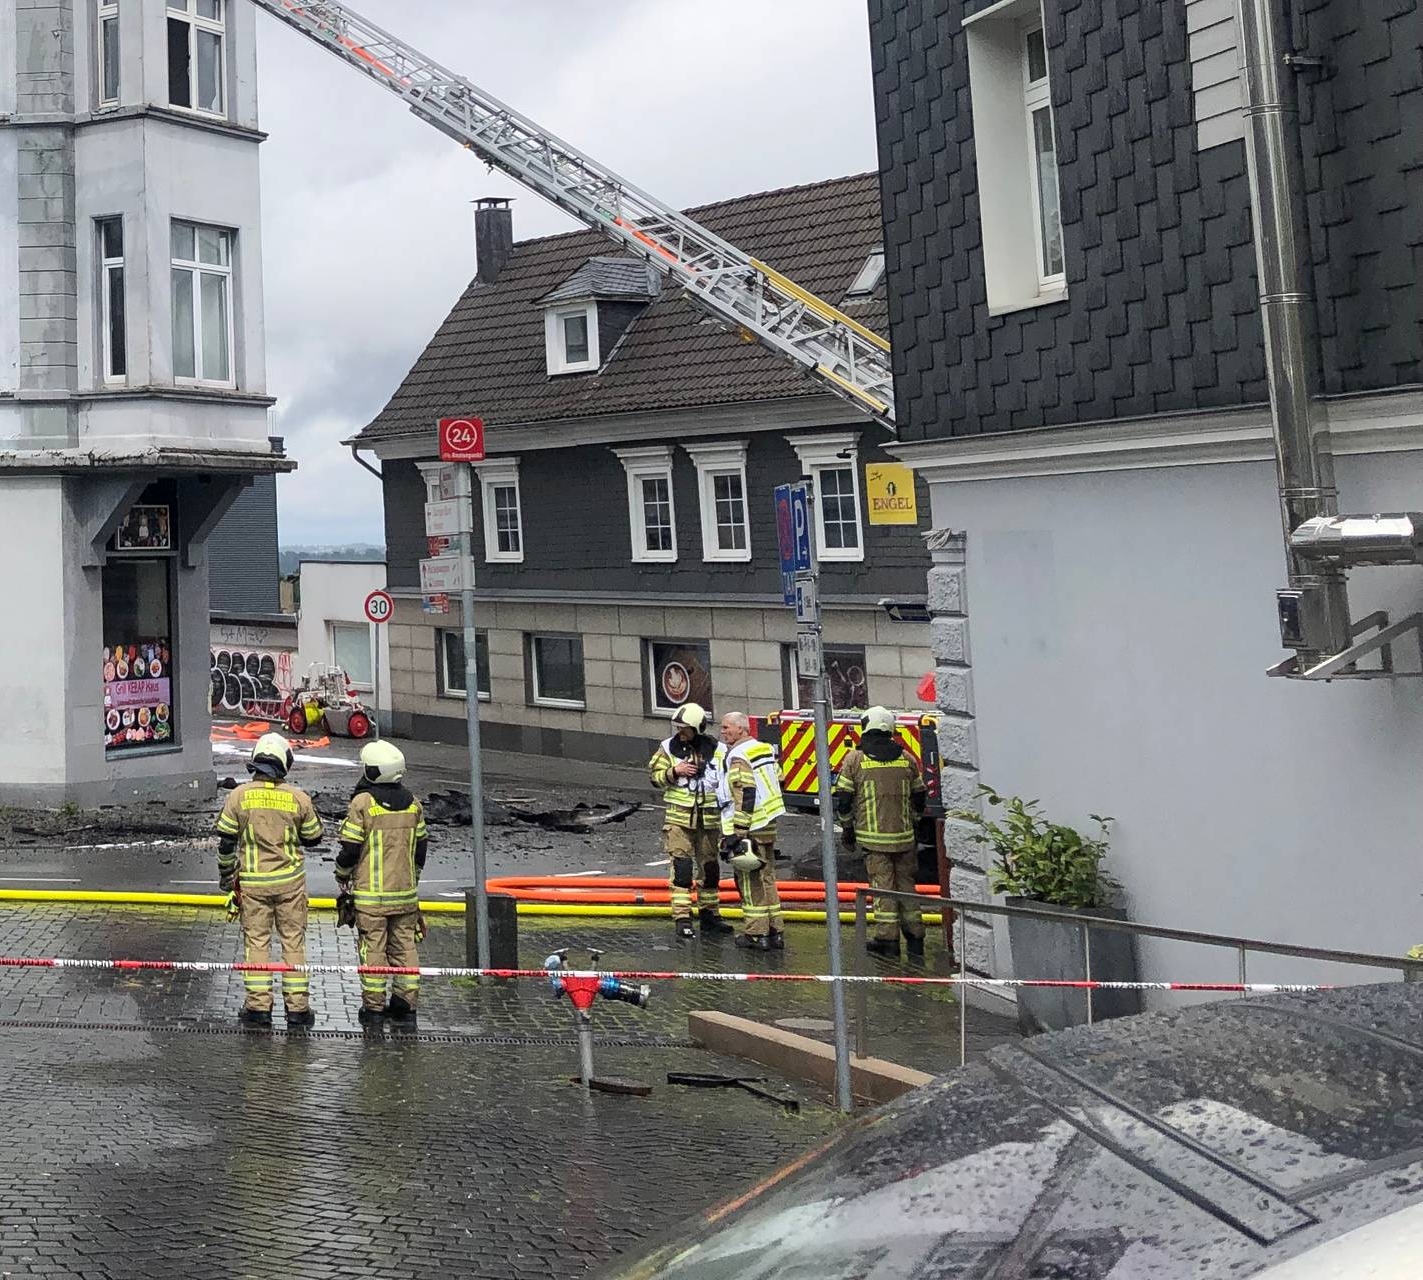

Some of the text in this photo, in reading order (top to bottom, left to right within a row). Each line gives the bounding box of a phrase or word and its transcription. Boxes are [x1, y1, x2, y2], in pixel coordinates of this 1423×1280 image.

[452, 428, 471, 443] 24
[872, 497, 913, 511] ENGEL
[794, 499, 804, 561] P
[370, 600, 387, 615] 30
[244, 789, 294, 803] FEUERWEHR
